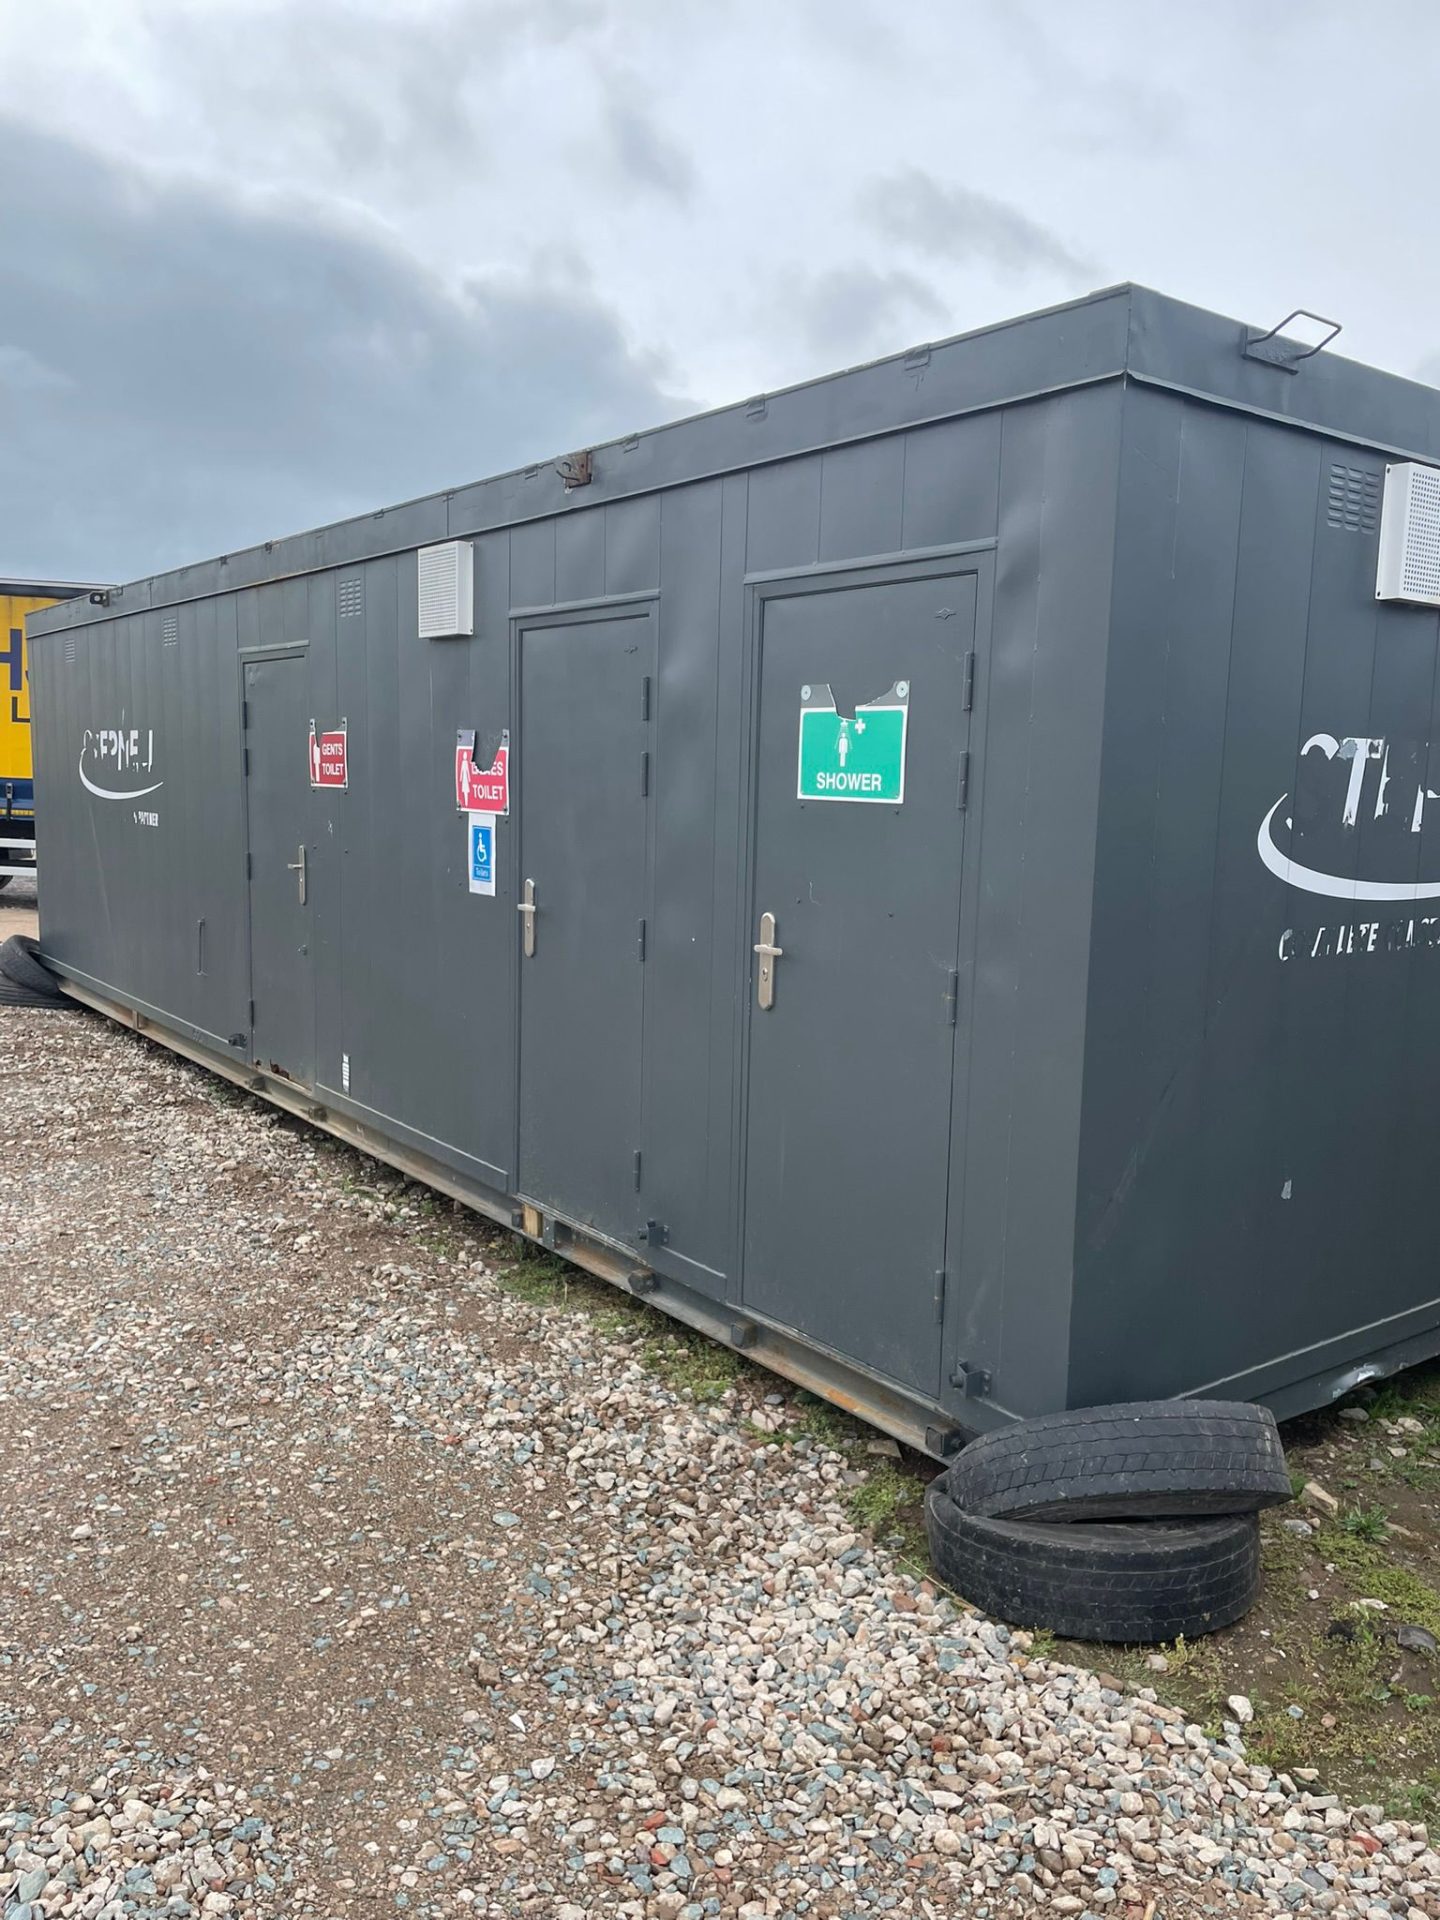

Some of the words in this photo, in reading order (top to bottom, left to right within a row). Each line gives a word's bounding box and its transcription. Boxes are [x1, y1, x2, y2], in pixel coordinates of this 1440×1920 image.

[321, 743, 343, 756] GENTS
[321, 763, 344, 776] TOILET
[815, 771, 882, 792] SHOWER
[472, 784, 504, 801] TOILET
